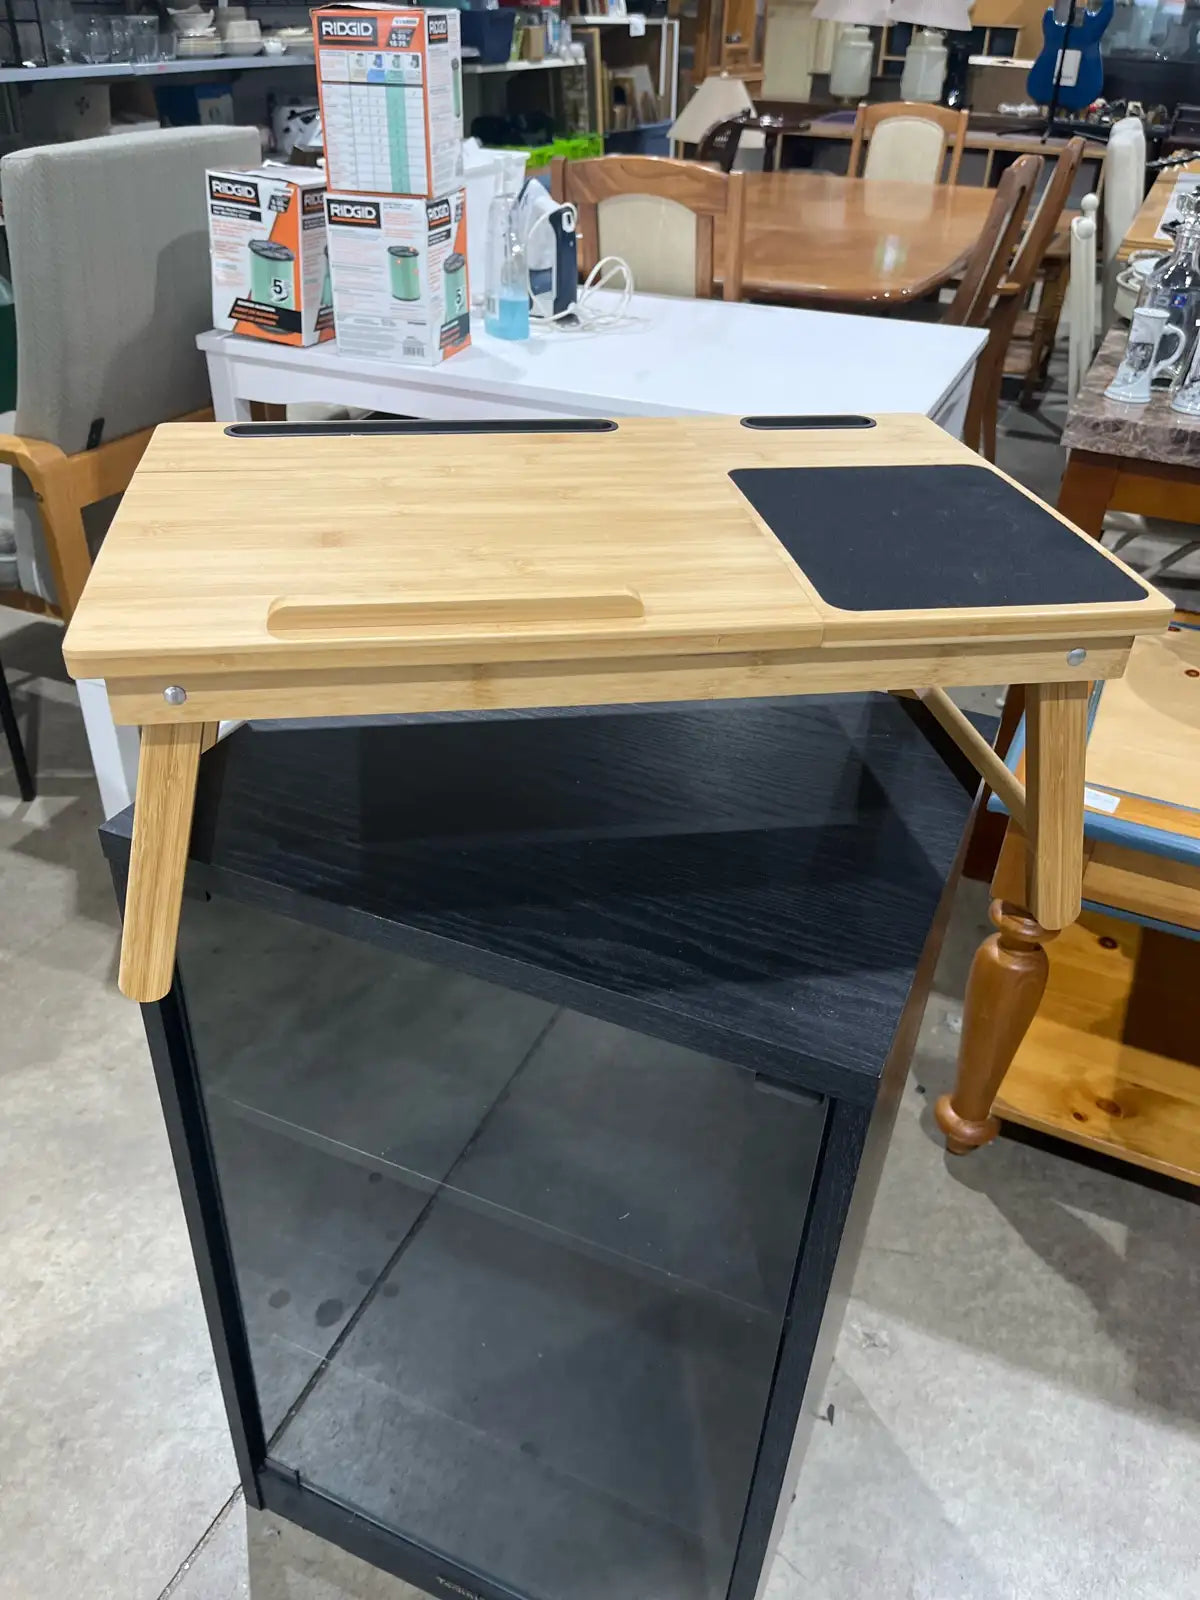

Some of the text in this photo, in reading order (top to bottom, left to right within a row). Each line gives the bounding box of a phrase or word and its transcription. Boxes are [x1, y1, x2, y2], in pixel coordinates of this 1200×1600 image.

[321, 21, 373, 37] RIDGID
[428, 20, 448, 34] RIDGID
[211, 180, 256, 199] RIDGID
[303, 191, 324, 207] RIDG
[329, 202, 377, 220] RIDGID
[427, 204, 450, 220] RIDGID
[273, 279, 283, 295] 5
[456, 288, 462, 305] 5
